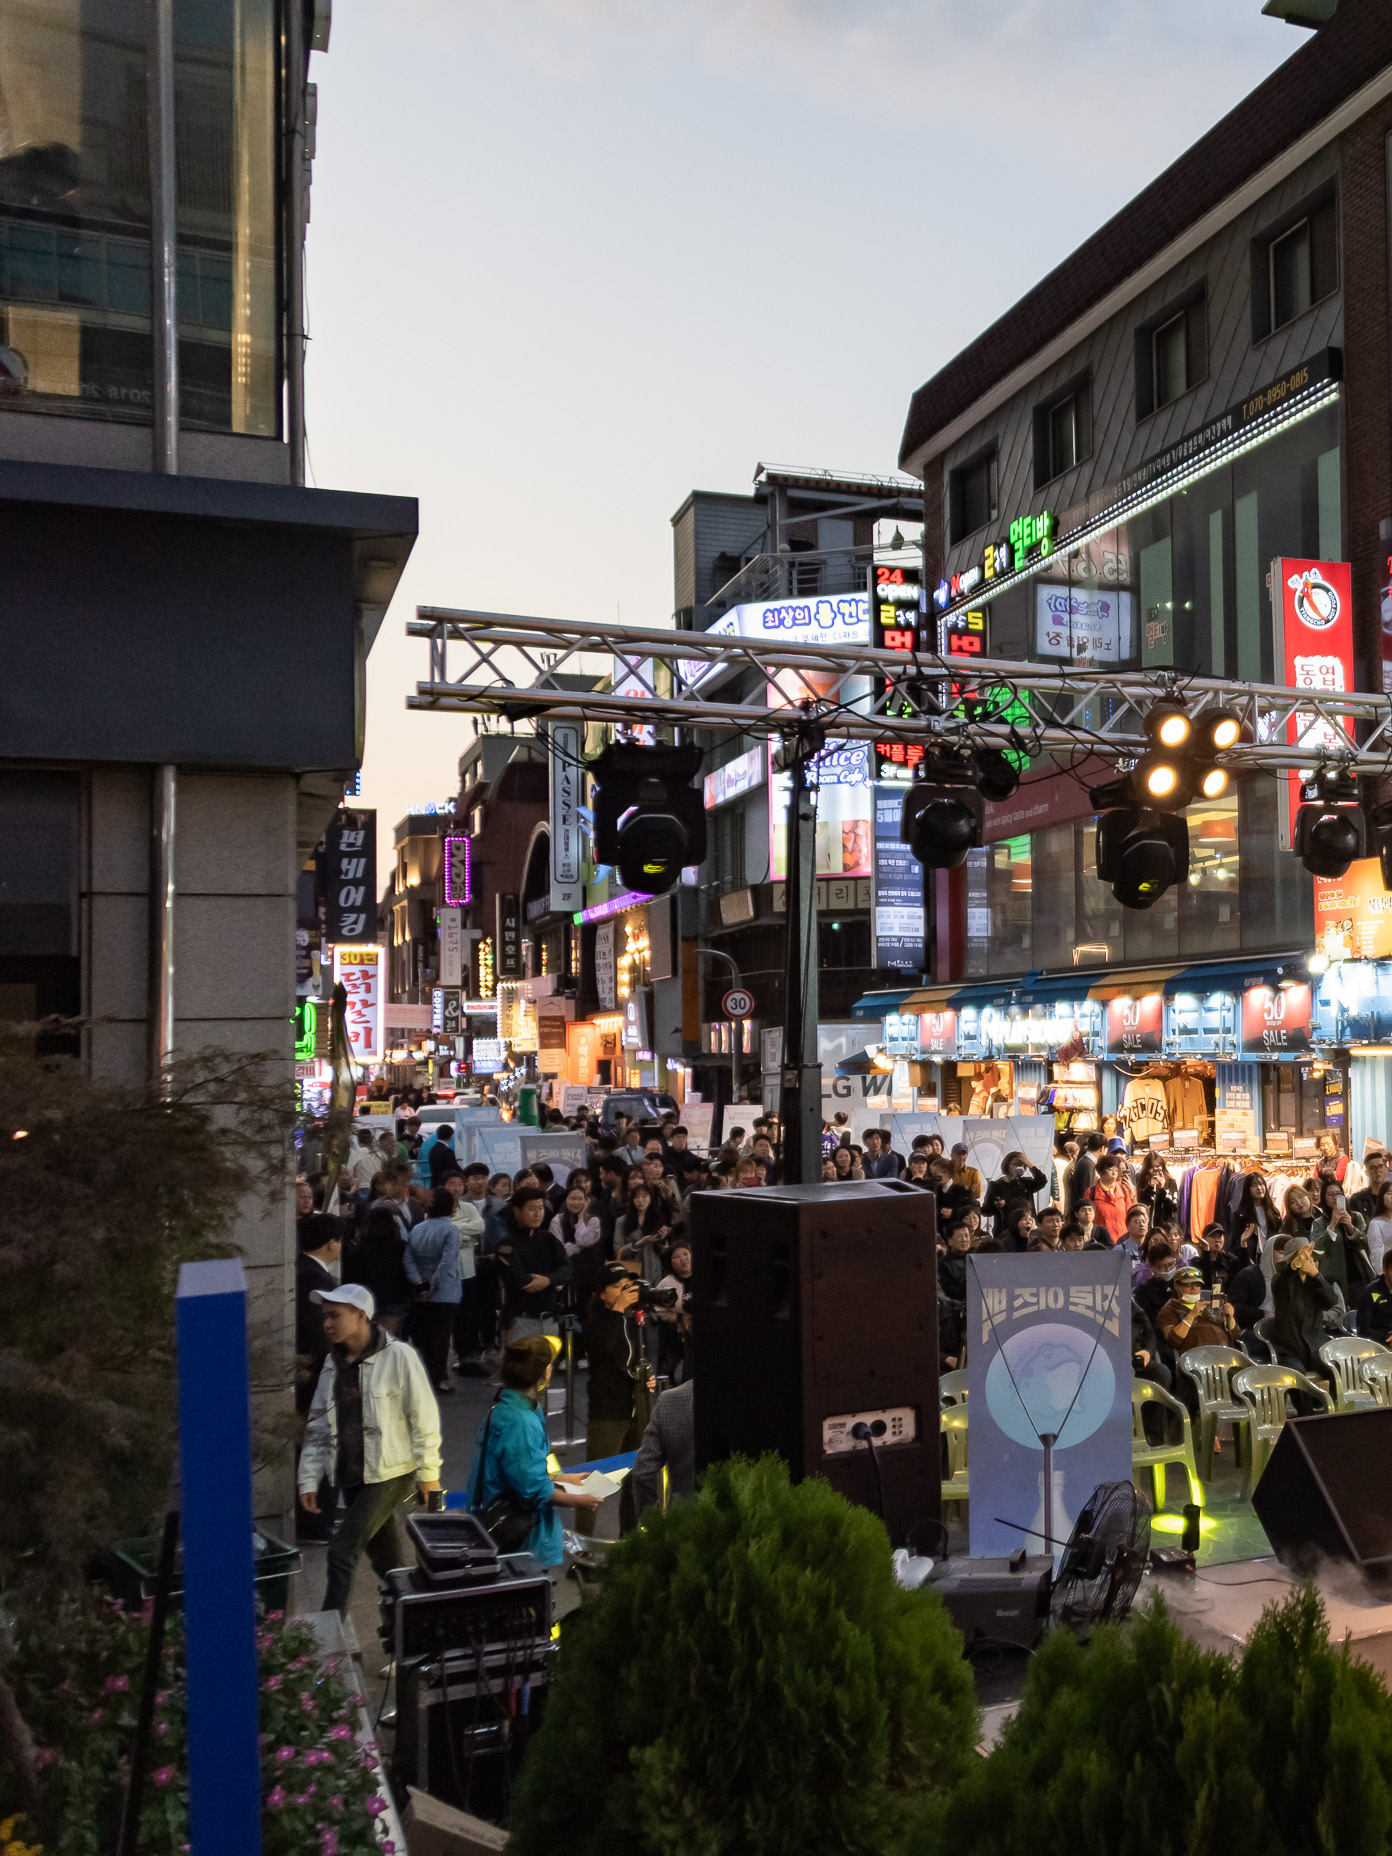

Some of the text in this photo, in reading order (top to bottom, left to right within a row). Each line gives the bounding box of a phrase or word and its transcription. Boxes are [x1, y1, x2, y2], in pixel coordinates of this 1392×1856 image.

[1010, 510, 1052, 570] 멀티방
[876, 567, 904, 586] 24
[763, 605, 811, 629] 최상의
[1123, 1001, 1140, 1026] 50
[1264, 993, 1286, 1021] 50
[930, 1038, 944, 1051] SALE
[1122, 1034, 1142, 1048] SALE
[1262, 1030, 1288, 1046] SALE
